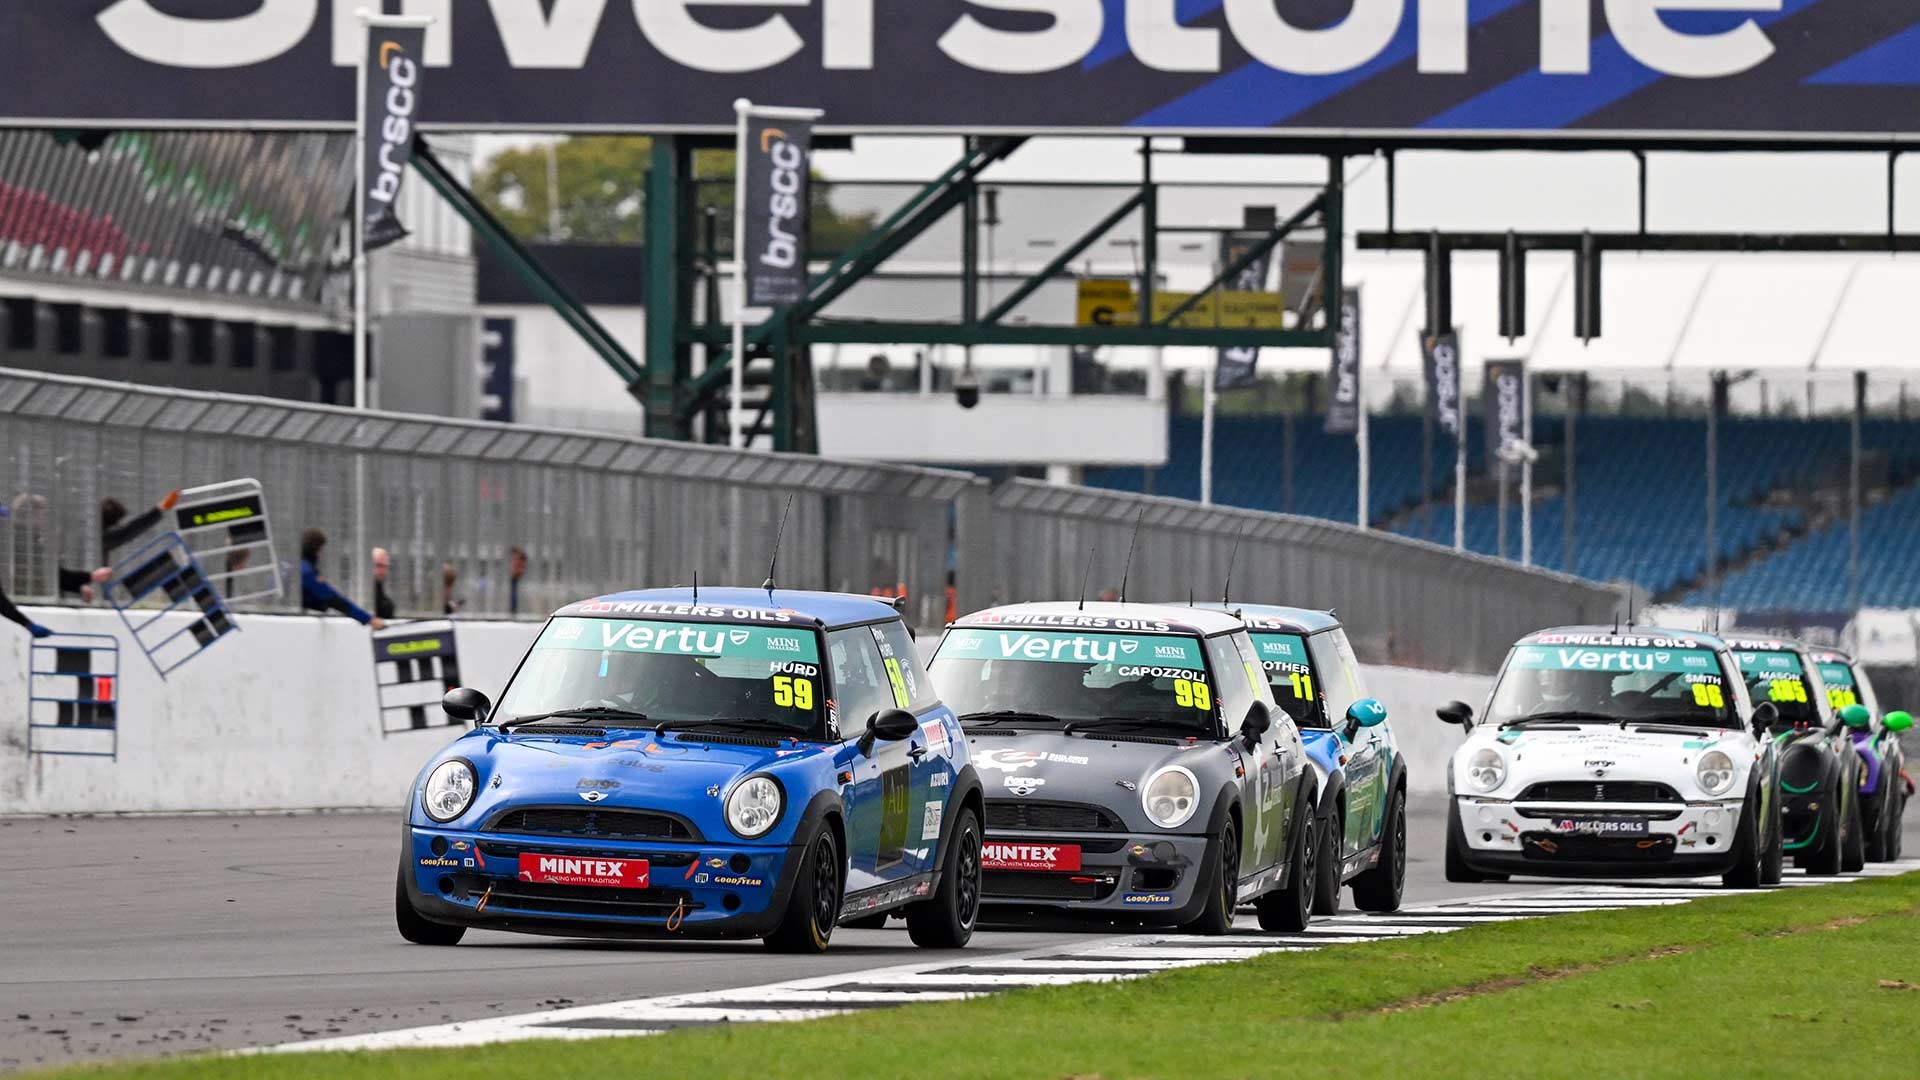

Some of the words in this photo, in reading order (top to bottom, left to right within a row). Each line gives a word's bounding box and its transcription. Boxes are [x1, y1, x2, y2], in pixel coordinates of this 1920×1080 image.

[370, 57, 416, 203] brscc
[761, 141, 800, 271] brscc
[615, 602, 725, 618] MILLERS
[731, 608, 791, 623] OILS
[1003, 613, 1108, 628] MILLERS
[1114, 618, 1170, 632] OILS
[602, 622, 726, 654] Vertu
[766, 636, 800, 648] MINI
[1564, 635, 1652, 648] MILLERS
[1653, 637, 1698, 649] OILS
[1000, 633, 1117, 662] Vertu
[1153, 645, 1185, 656] MINI
[1263, 642, 1291, 652] MINI
[1259, 660, 1310, 675] OTHER
[1558, 648, 1655, 671] Vertu
[769, 661, 818, 677] HURD
[1118, 665, 1205, 684] CAPOZZOLI
[1758, 671, 1801, 682] MASON
[1288, 672, 1314, 702] 11
[1684, 672, 1722, 686] SMITH
[773, 675, 814, 711] 59
[1174, 679, 1212, 712] 99
[1620, 822, 1643, 833] OILS
[420, 855, 459, 868] GOODYEAR
[980, 844, 1058, 862] MINTEX
[540, 857, 624, 877] MINTEX
[569, 876, 586, 884] WITH
[586, 877, 621, 886] TRADITION
[714, 876, 762, 887] GOODYEAR
[1125, 894, 1171, 904] GOODYEAR
